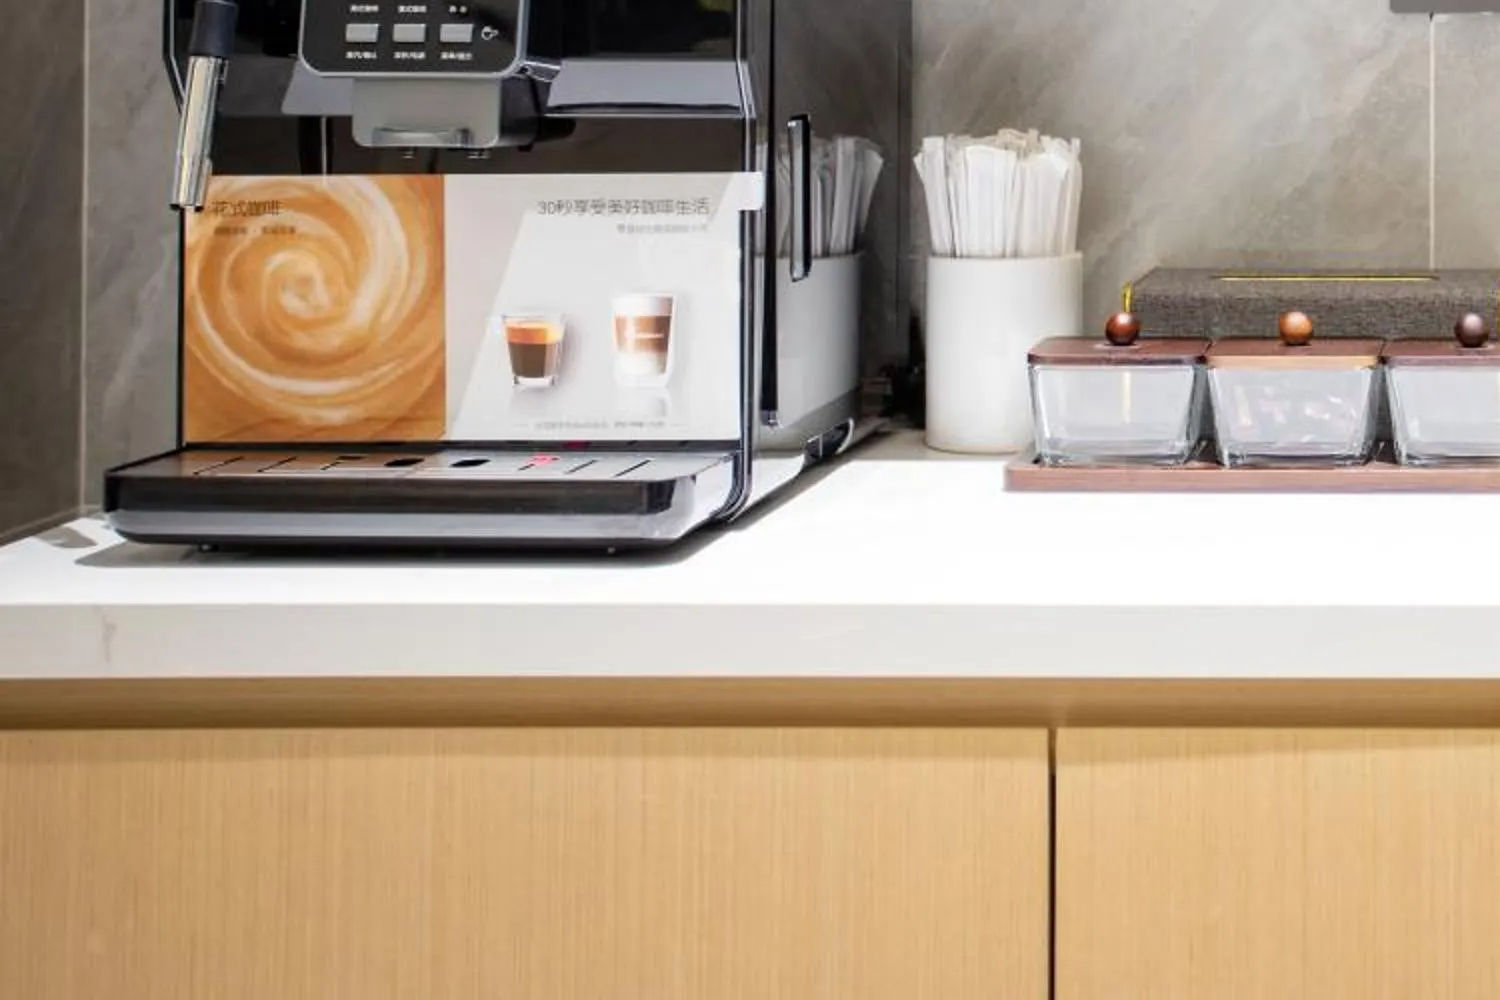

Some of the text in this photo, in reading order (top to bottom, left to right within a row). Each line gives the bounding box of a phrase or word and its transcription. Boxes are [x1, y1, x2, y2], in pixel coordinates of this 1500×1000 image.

[537, 197, 711, 216] 30秒享受美好咖啡生活
